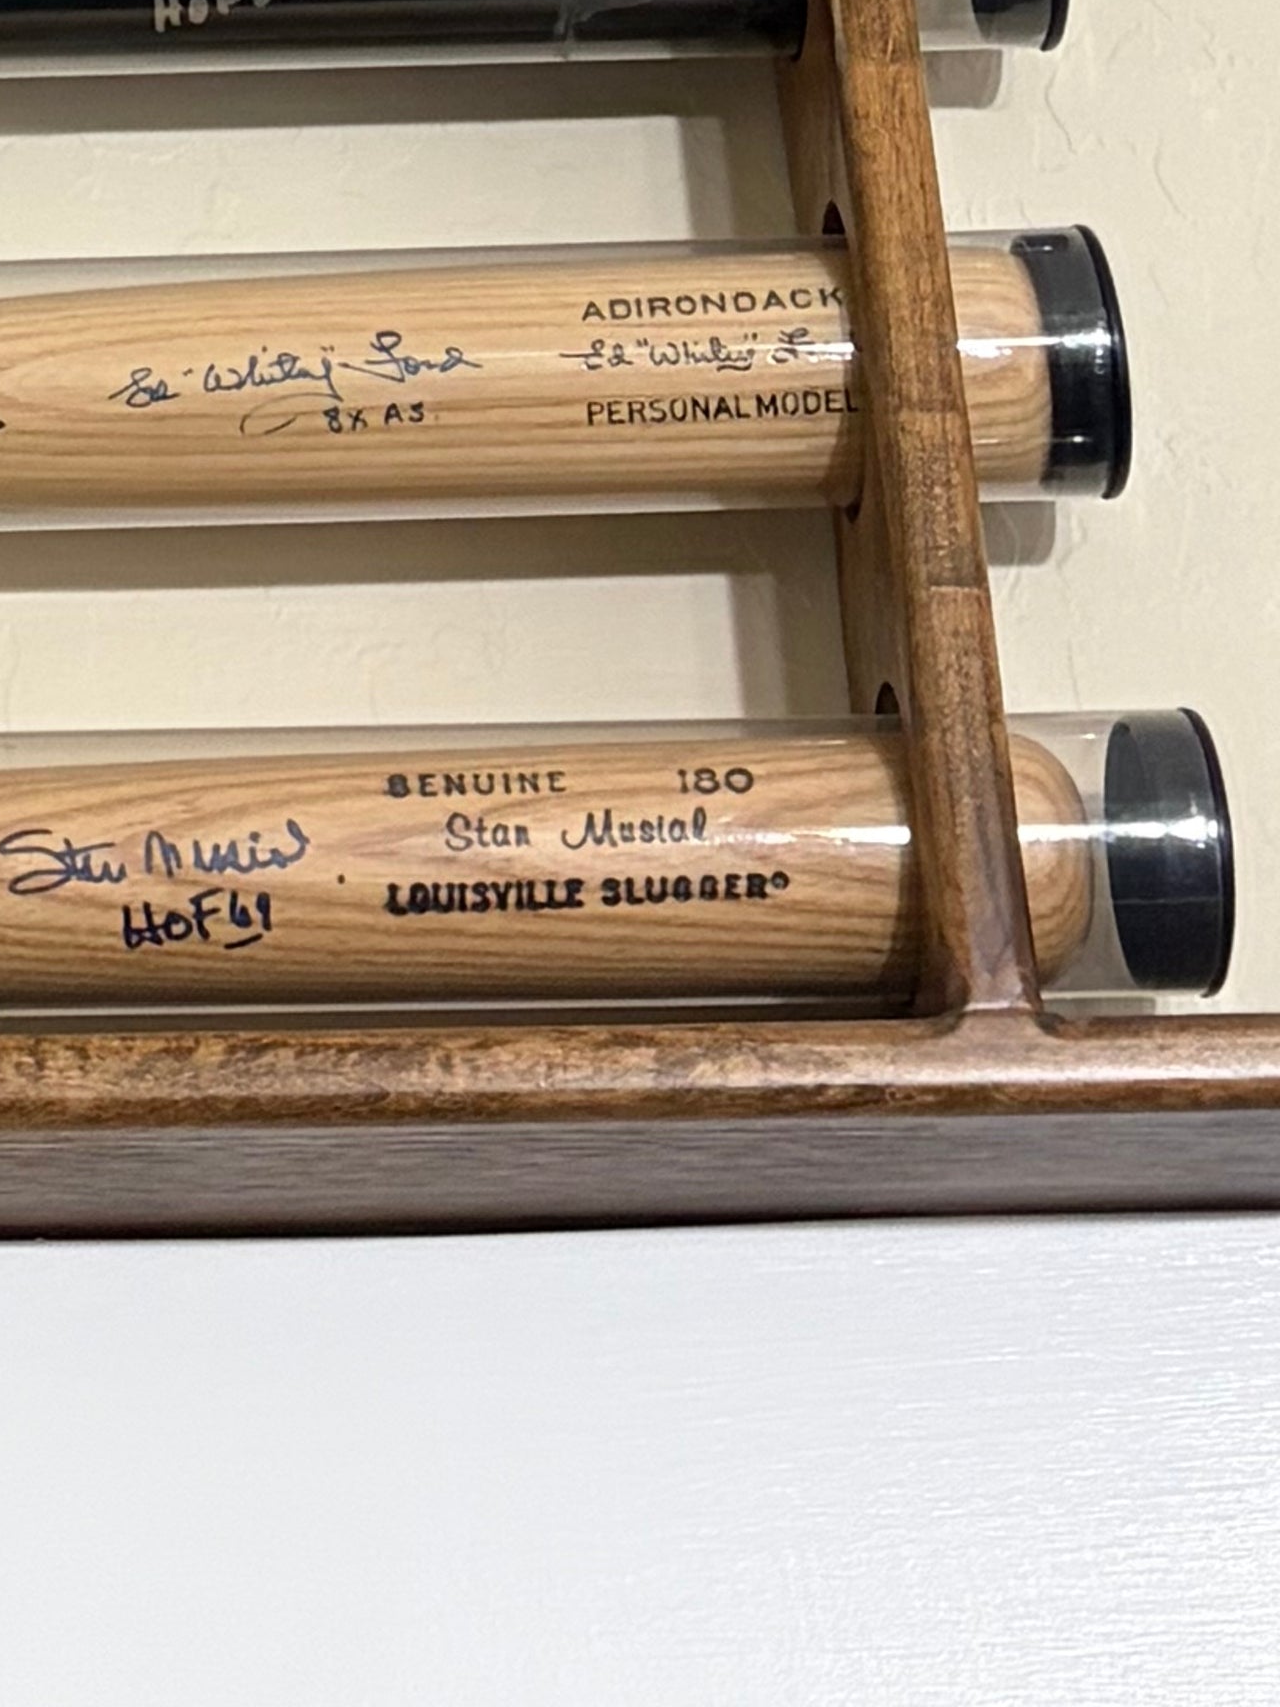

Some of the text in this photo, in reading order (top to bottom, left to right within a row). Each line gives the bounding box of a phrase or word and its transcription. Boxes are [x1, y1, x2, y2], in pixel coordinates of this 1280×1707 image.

[581, 287, 845, 323] ADIRONDACK
[585, 387, 859, 427] PERSONAL MODEL
[383, 767, 755, 799] GENUINE 180
[444, 806, 709, 852] Stan Musial
[383, 877, 586, 917] LOUISVILLE
